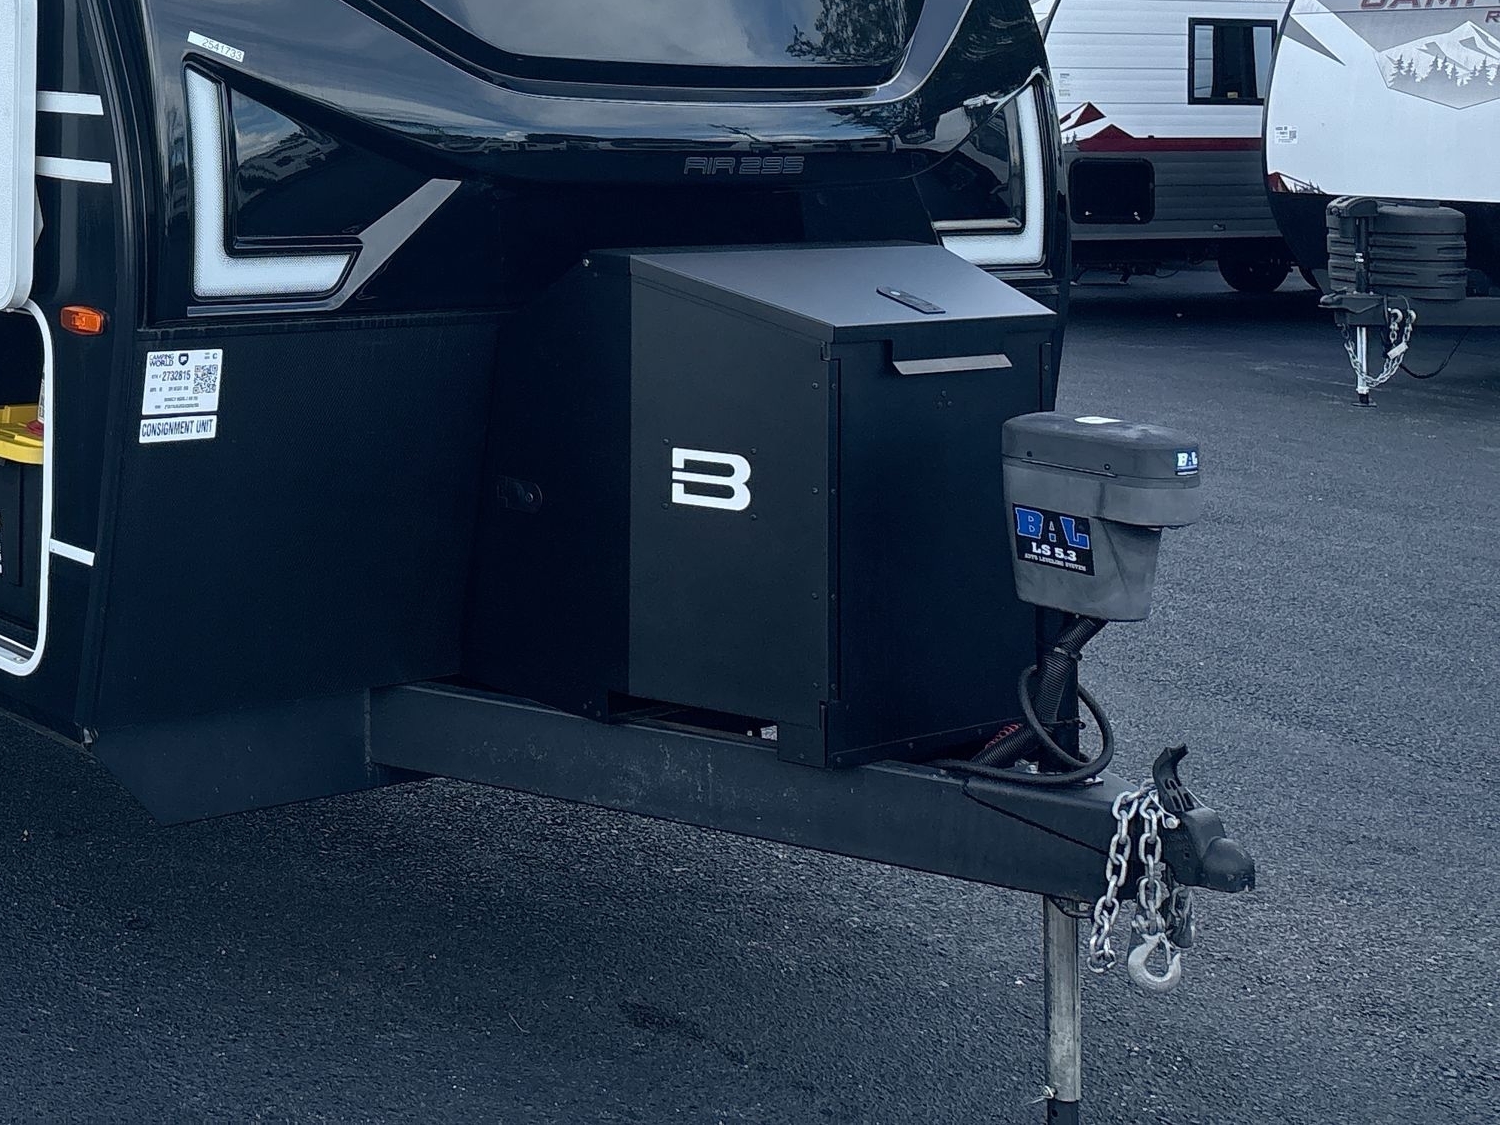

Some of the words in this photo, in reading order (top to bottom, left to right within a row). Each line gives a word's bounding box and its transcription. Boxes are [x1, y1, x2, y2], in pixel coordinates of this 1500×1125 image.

[202, 38, 242, 61] 2541733
[683, 156, 736, 175] AIR
[739, 156, 805, 175] 295
[149, 353, 175, 361] CAMPING
[149, 359, 174, 367] WORLD
[141, 420, 194, 437] CONSIGNMENT
[196, 419, 213, 434] UNIT
[672, 447, 751, 511] B
[1015, 507, 1090, 550] BAL
[1031, 541, 1052, 556] LS
[1054, 547, 1077, 562] 5.3
